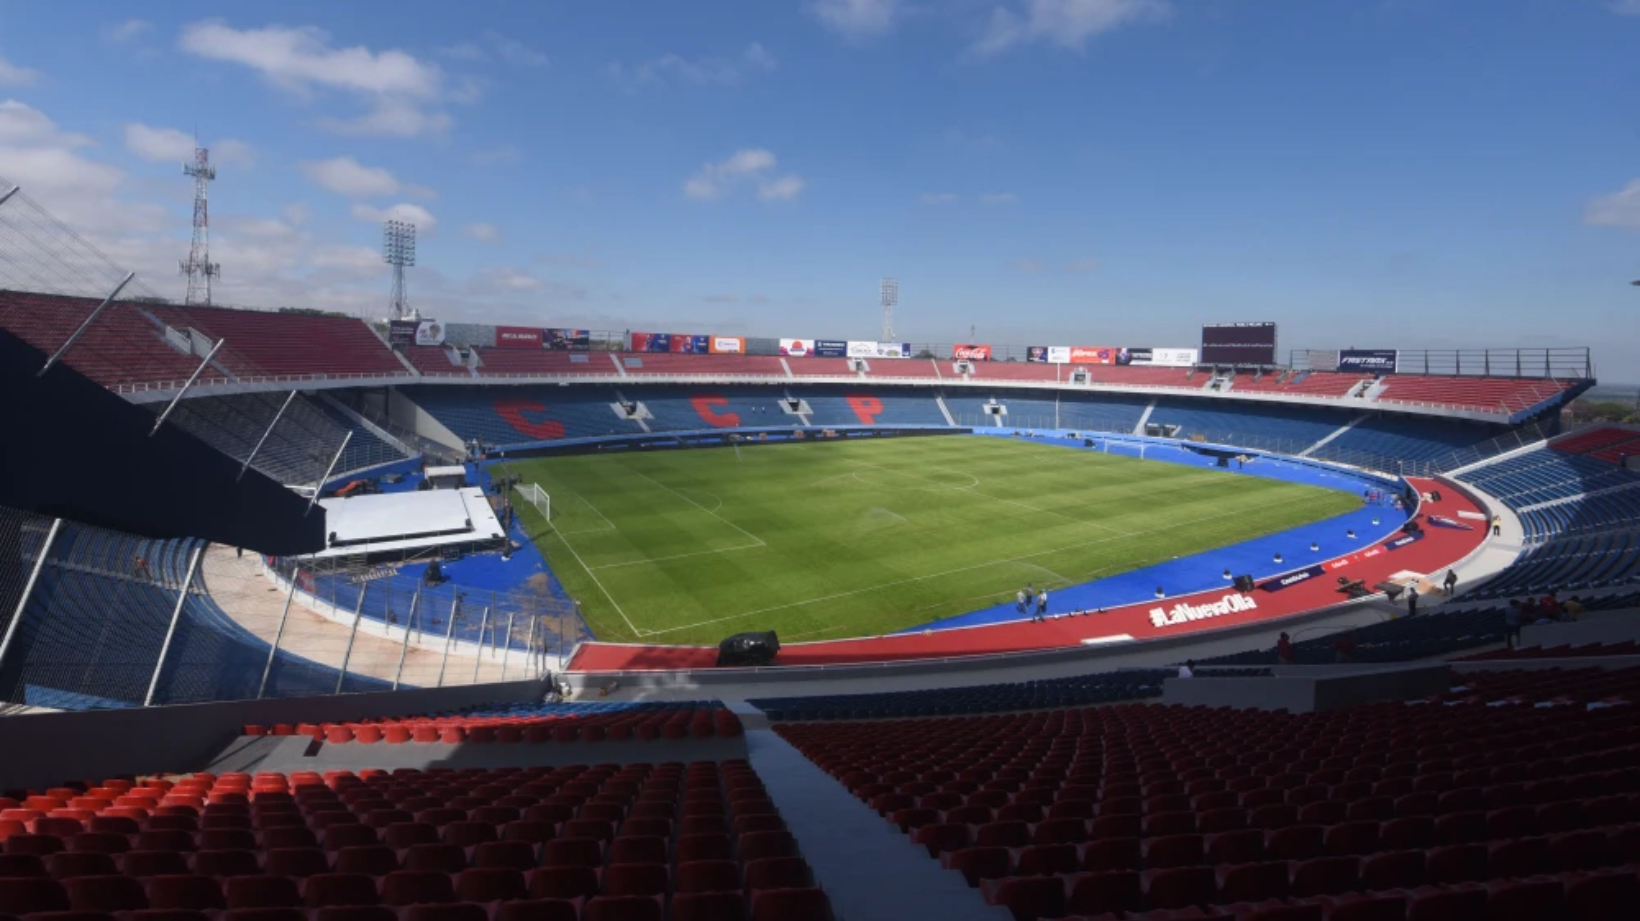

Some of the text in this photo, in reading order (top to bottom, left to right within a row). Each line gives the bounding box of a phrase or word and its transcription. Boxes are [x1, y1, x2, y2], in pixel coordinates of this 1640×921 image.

[691, 394, 740, 427] C
[845, 394, 884, 425] P
[1149, 593, 1258, 628] #LaNuevaOlla
